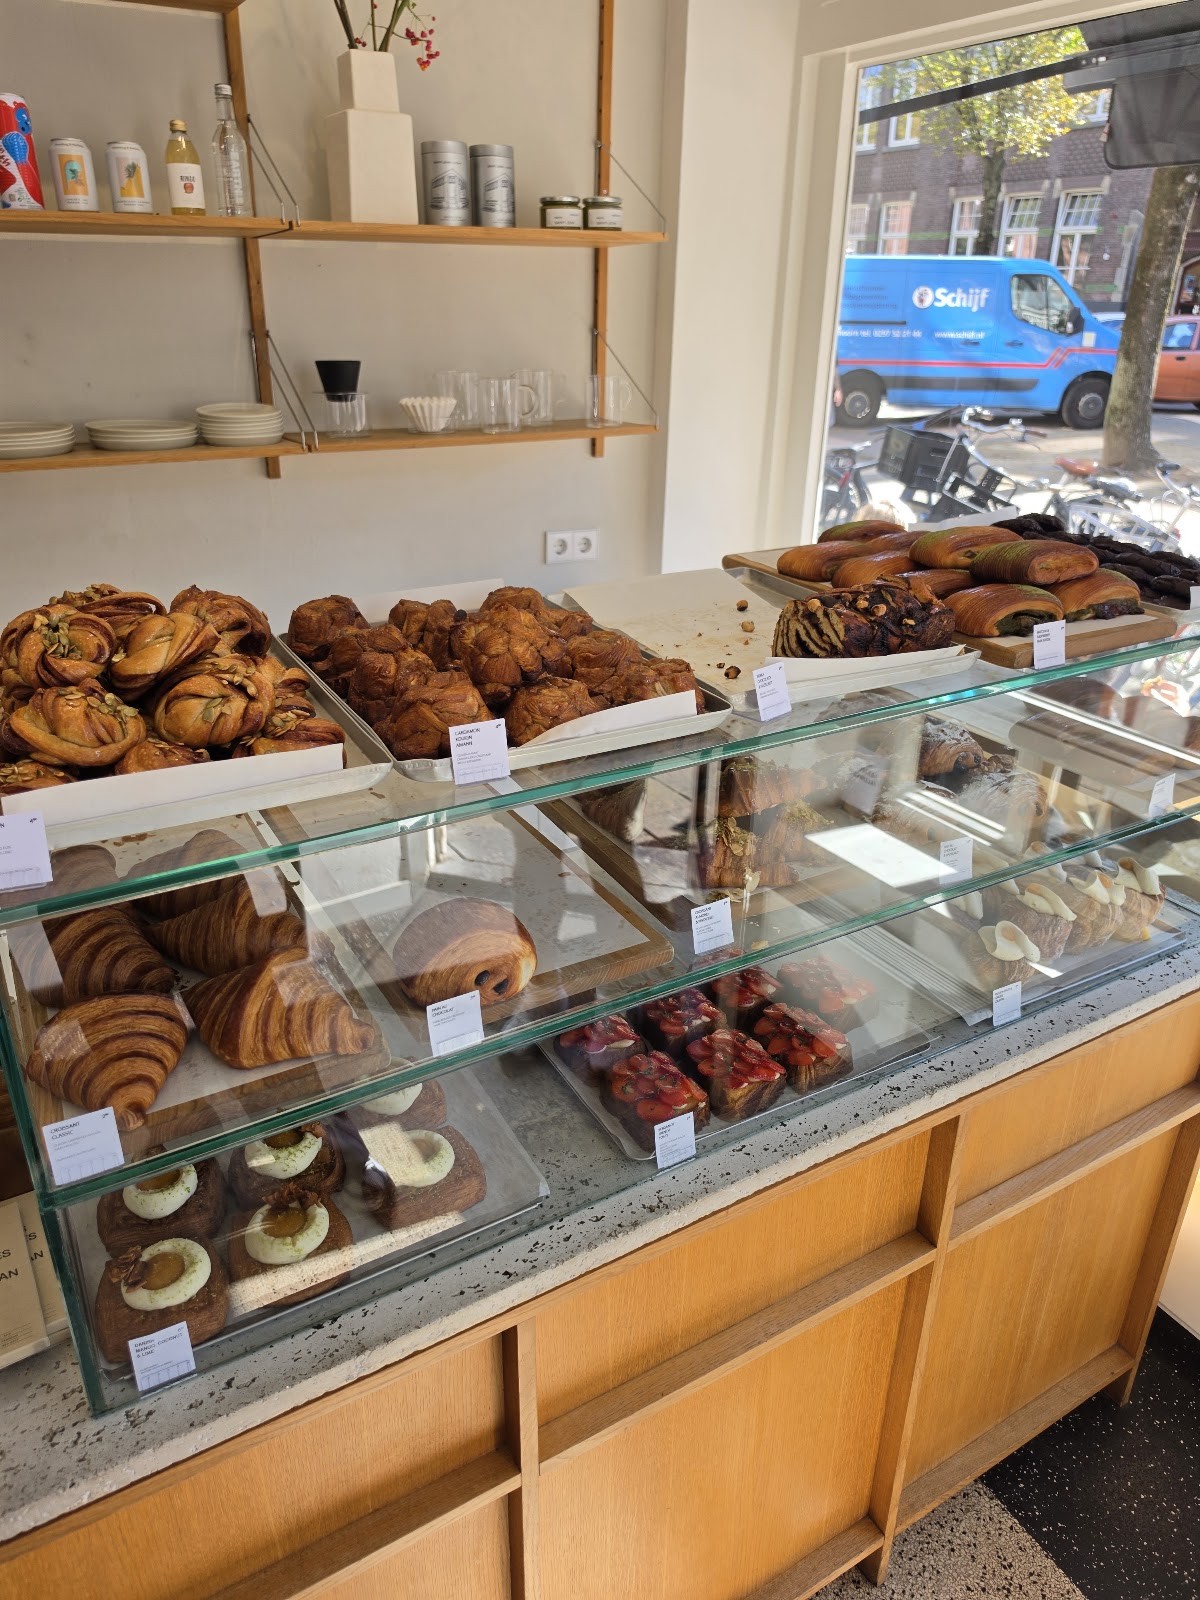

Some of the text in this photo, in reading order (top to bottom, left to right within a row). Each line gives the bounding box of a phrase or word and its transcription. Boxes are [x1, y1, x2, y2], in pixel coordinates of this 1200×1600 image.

[934, 287, 990, 312] Schijf
[50, 1121, 80, 1133] CROISSANT
[51, 1129, 74, 1140] CLASSIC
